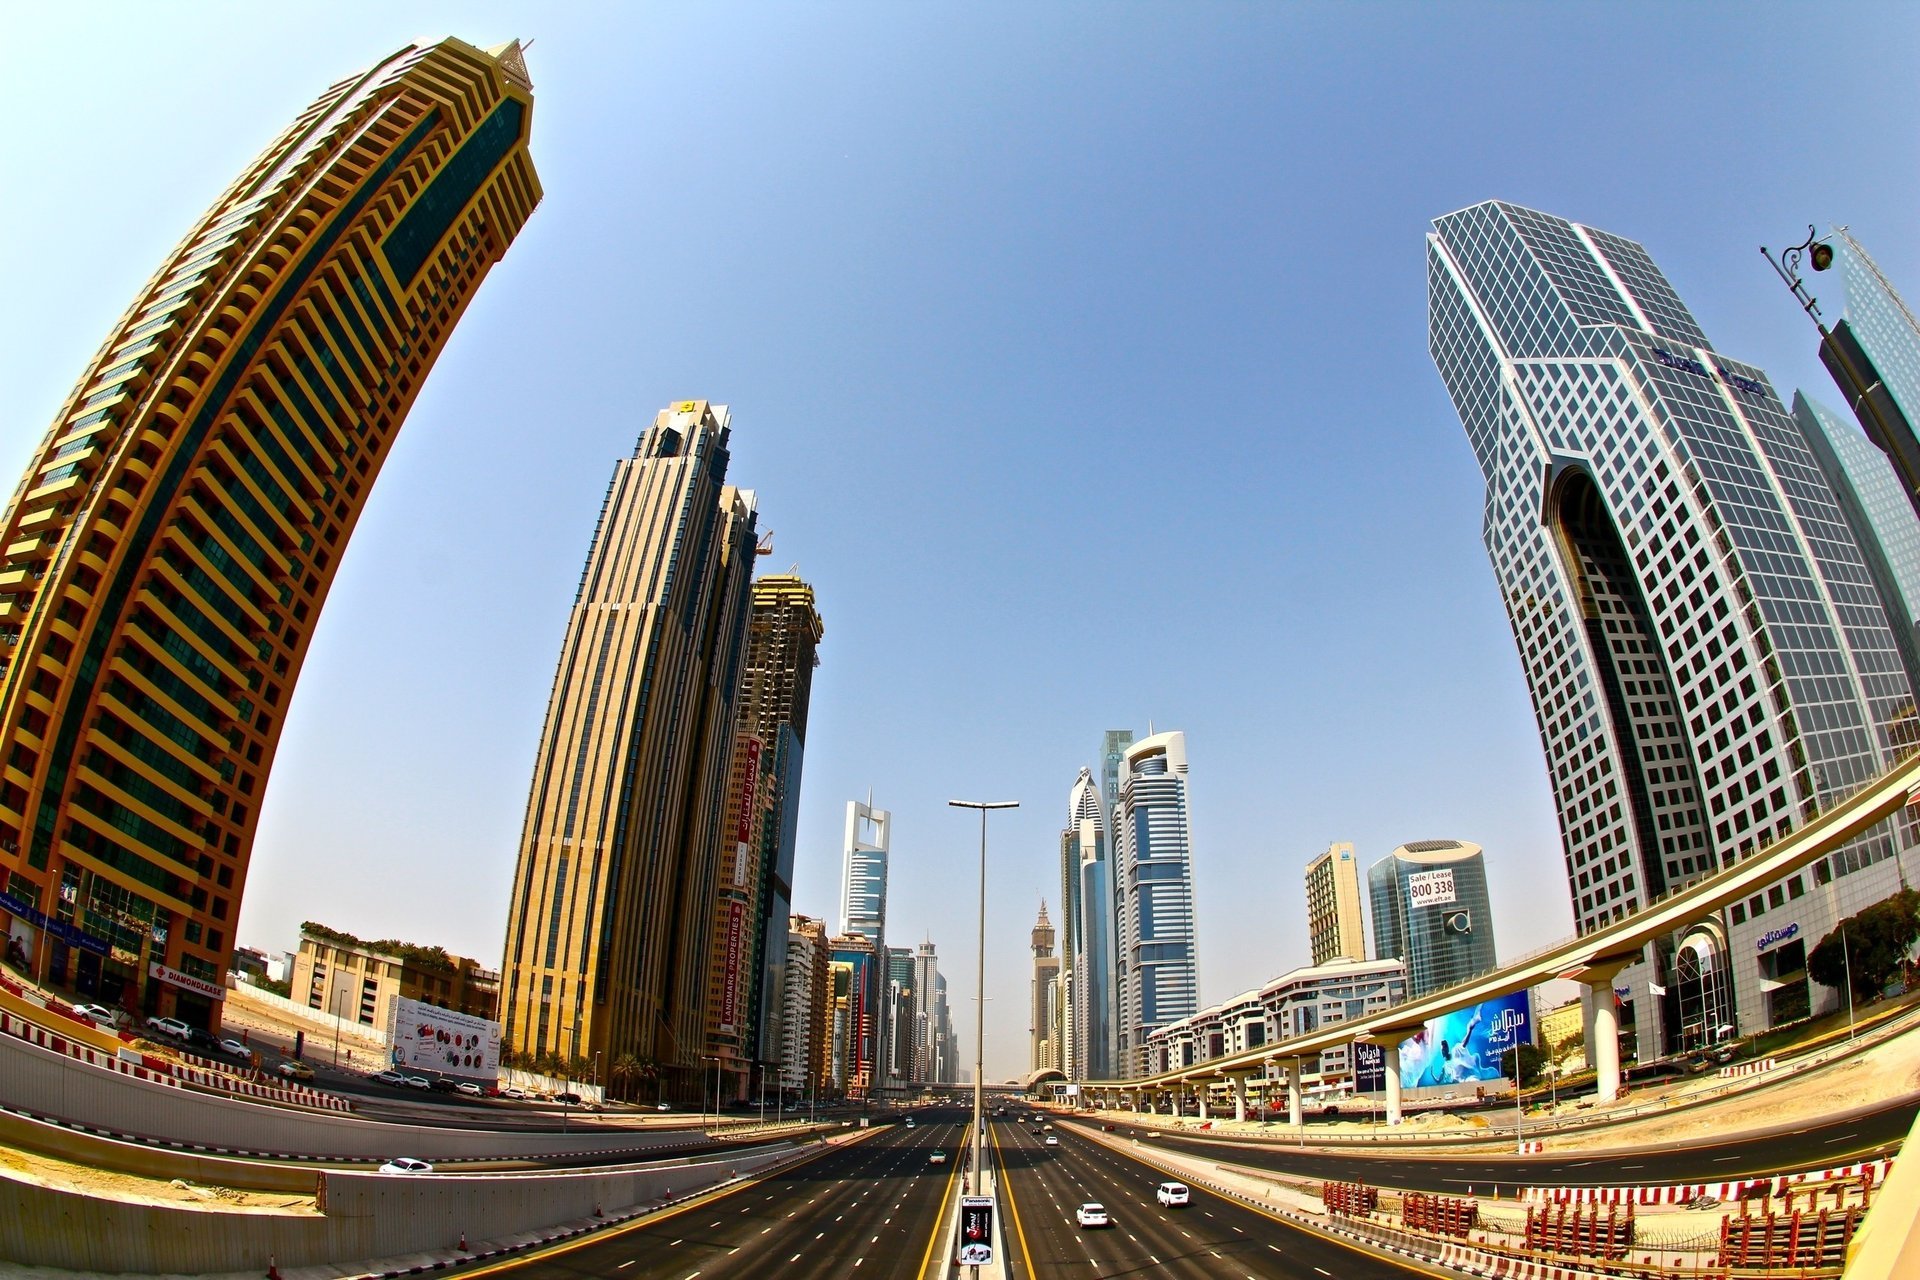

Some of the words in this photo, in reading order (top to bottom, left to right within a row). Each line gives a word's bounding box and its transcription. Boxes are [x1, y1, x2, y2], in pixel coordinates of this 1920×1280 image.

[1410, 874, 1427, 883] Sale
[1432, 871, 1452, 880] Lease
[1412, 883, 1432, 898] 800
[1434, 880, 1453, 894] 338
[728, 917, 739, 970] PROPERTIES
[168, 970, 222, 996] DIAMONDLEASE
[724, 972, 735, 1022] LANDMARK
[1358, 1044, 1380, 1066] Splash
